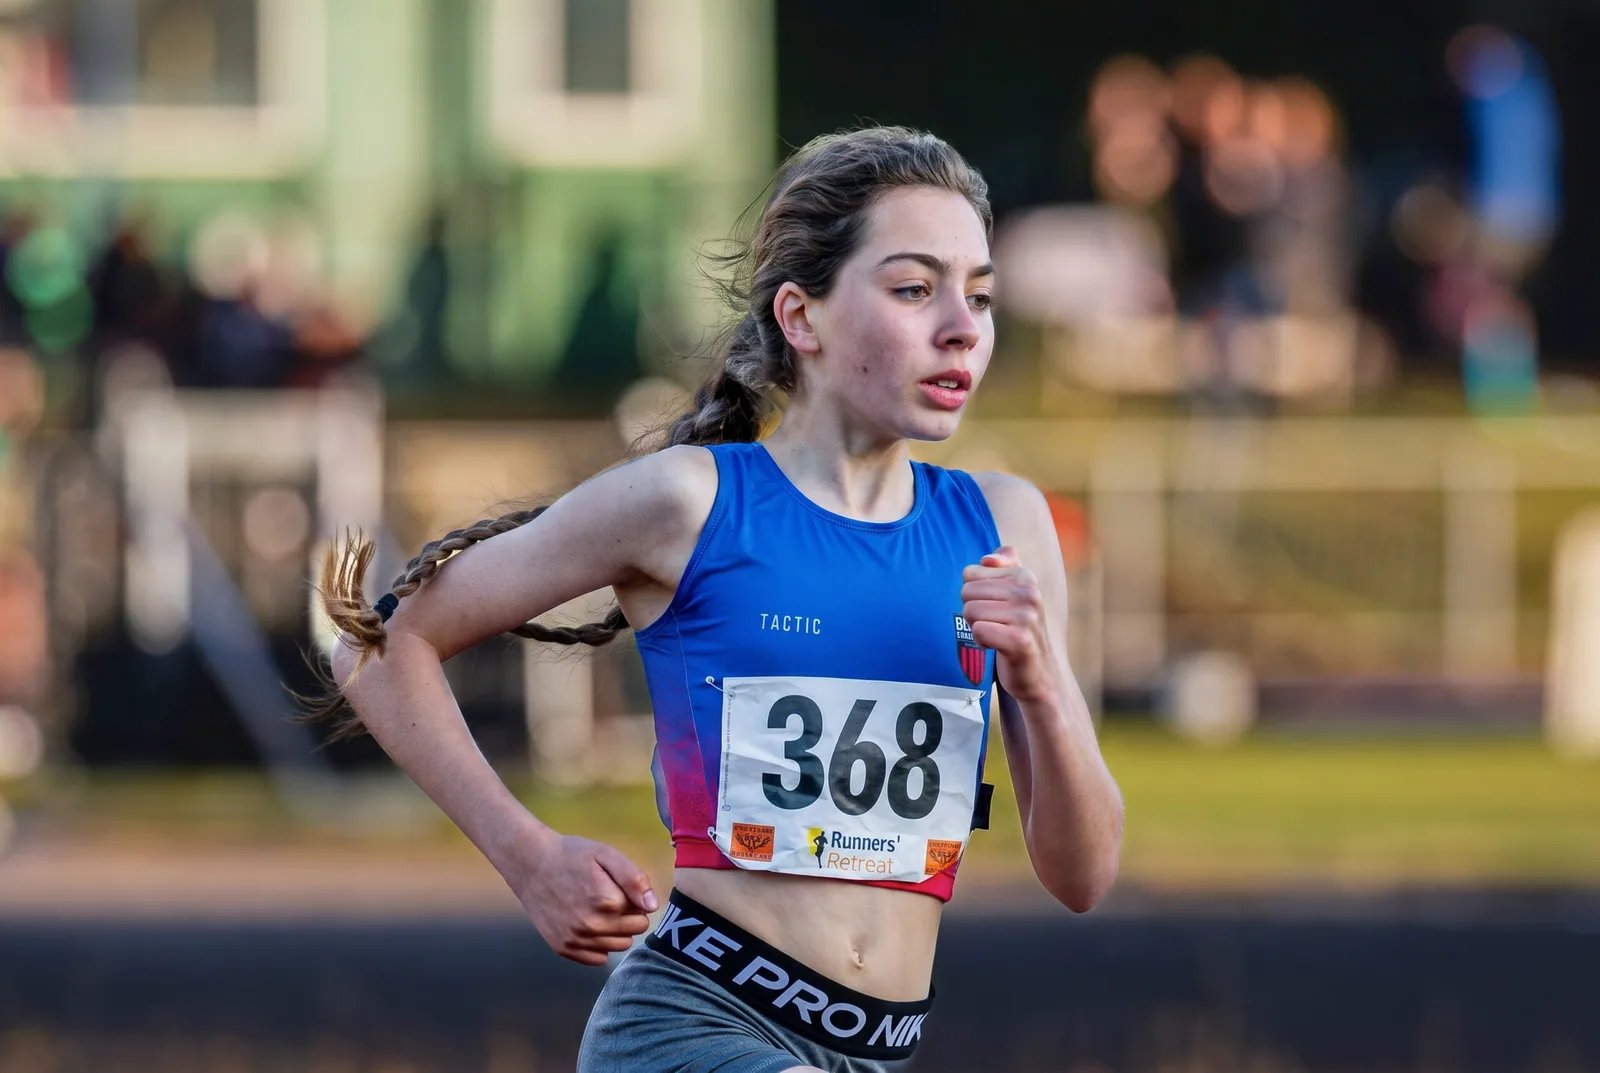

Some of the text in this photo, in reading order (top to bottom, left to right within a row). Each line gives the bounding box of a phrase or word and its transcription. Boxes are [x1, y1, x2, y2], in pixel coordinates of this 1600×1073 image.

[760, 613, 821, 635] TACTIC
[761, 694, 943, 820] 368
[831, 830, 901, 853] Runners'
[826, 852, 894, 874] Retreat
[653, 901, 742, 971] IKE
[732, 955, 867, 1038] PRO
